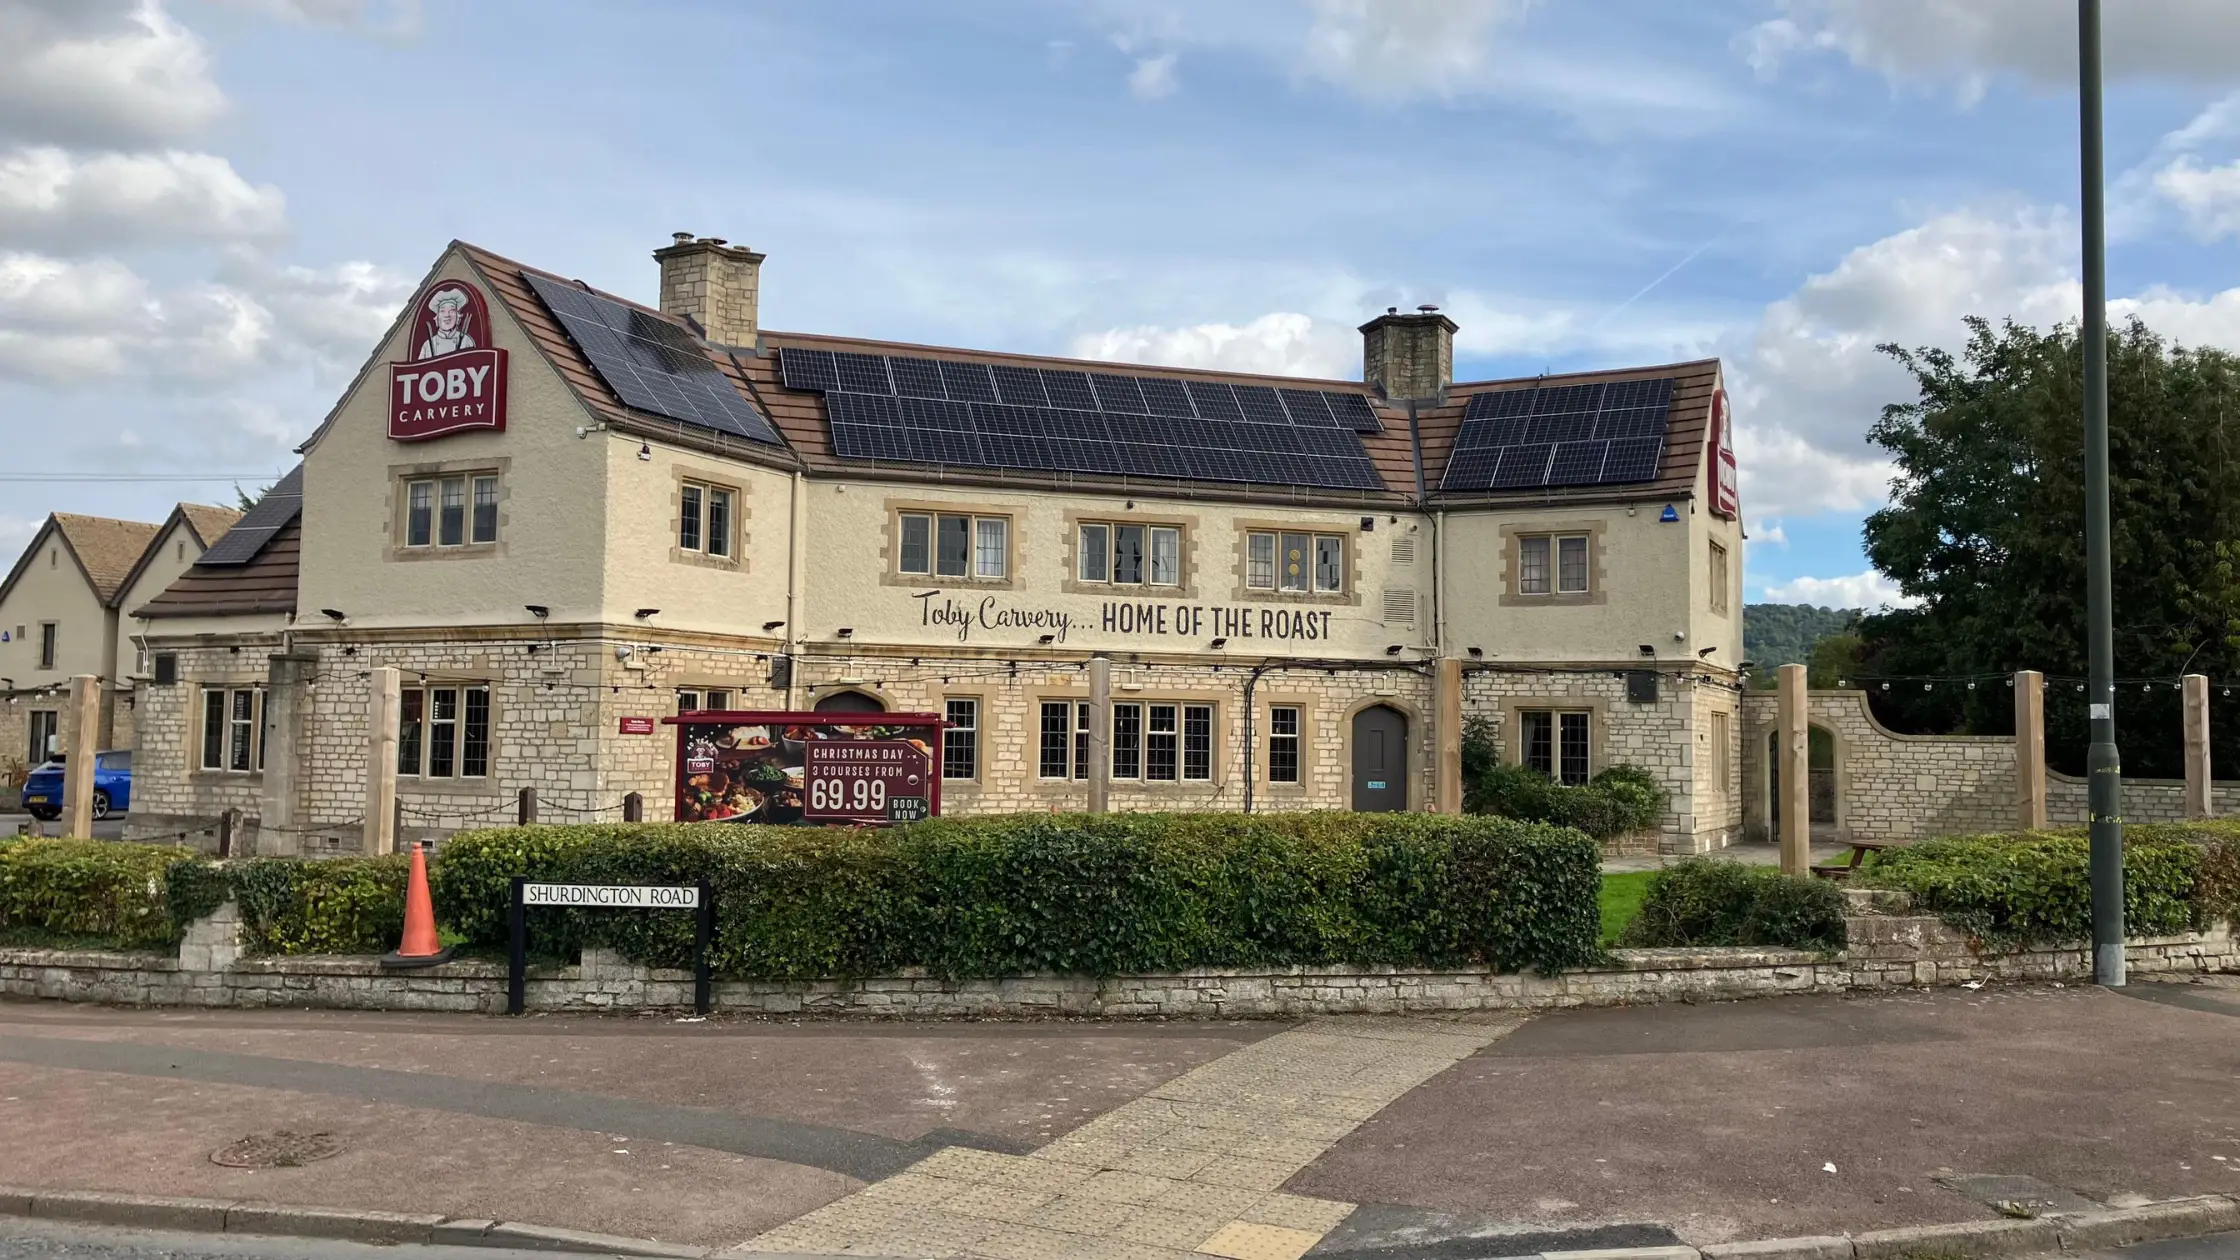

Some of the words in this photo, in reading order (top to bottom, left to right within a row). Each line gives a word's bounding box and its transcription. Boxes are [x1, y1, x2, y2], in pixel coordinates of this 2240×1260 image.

[396, 365, 490, 404] TOBY
[399, 403, 485, 422] CARVERY
[911, 590, 975, 642] Toby
[1102, 602, 1168, 634] HOME
[1176, 605, 1204, 636] OF
[1211, 607, 1253, 637] THE
[1261, 609, 1332, 640] ROAST
[813, 748, 878, 759] CHRISTMAS
[882, 748, 904, 760] DAY
[812, 765, 819, 776] 3
[823, 765, 870, 776] COURSES
[875, 766, 903, 777] FROM
[812, 778, 886, 810] 69.99
[893, 799, 919, 809] BOOK
[895, 810, 917, 820] NOW
[529, 886, 642, 904] SHURDINGTON
[650, 888, 694, 904] ROAD
